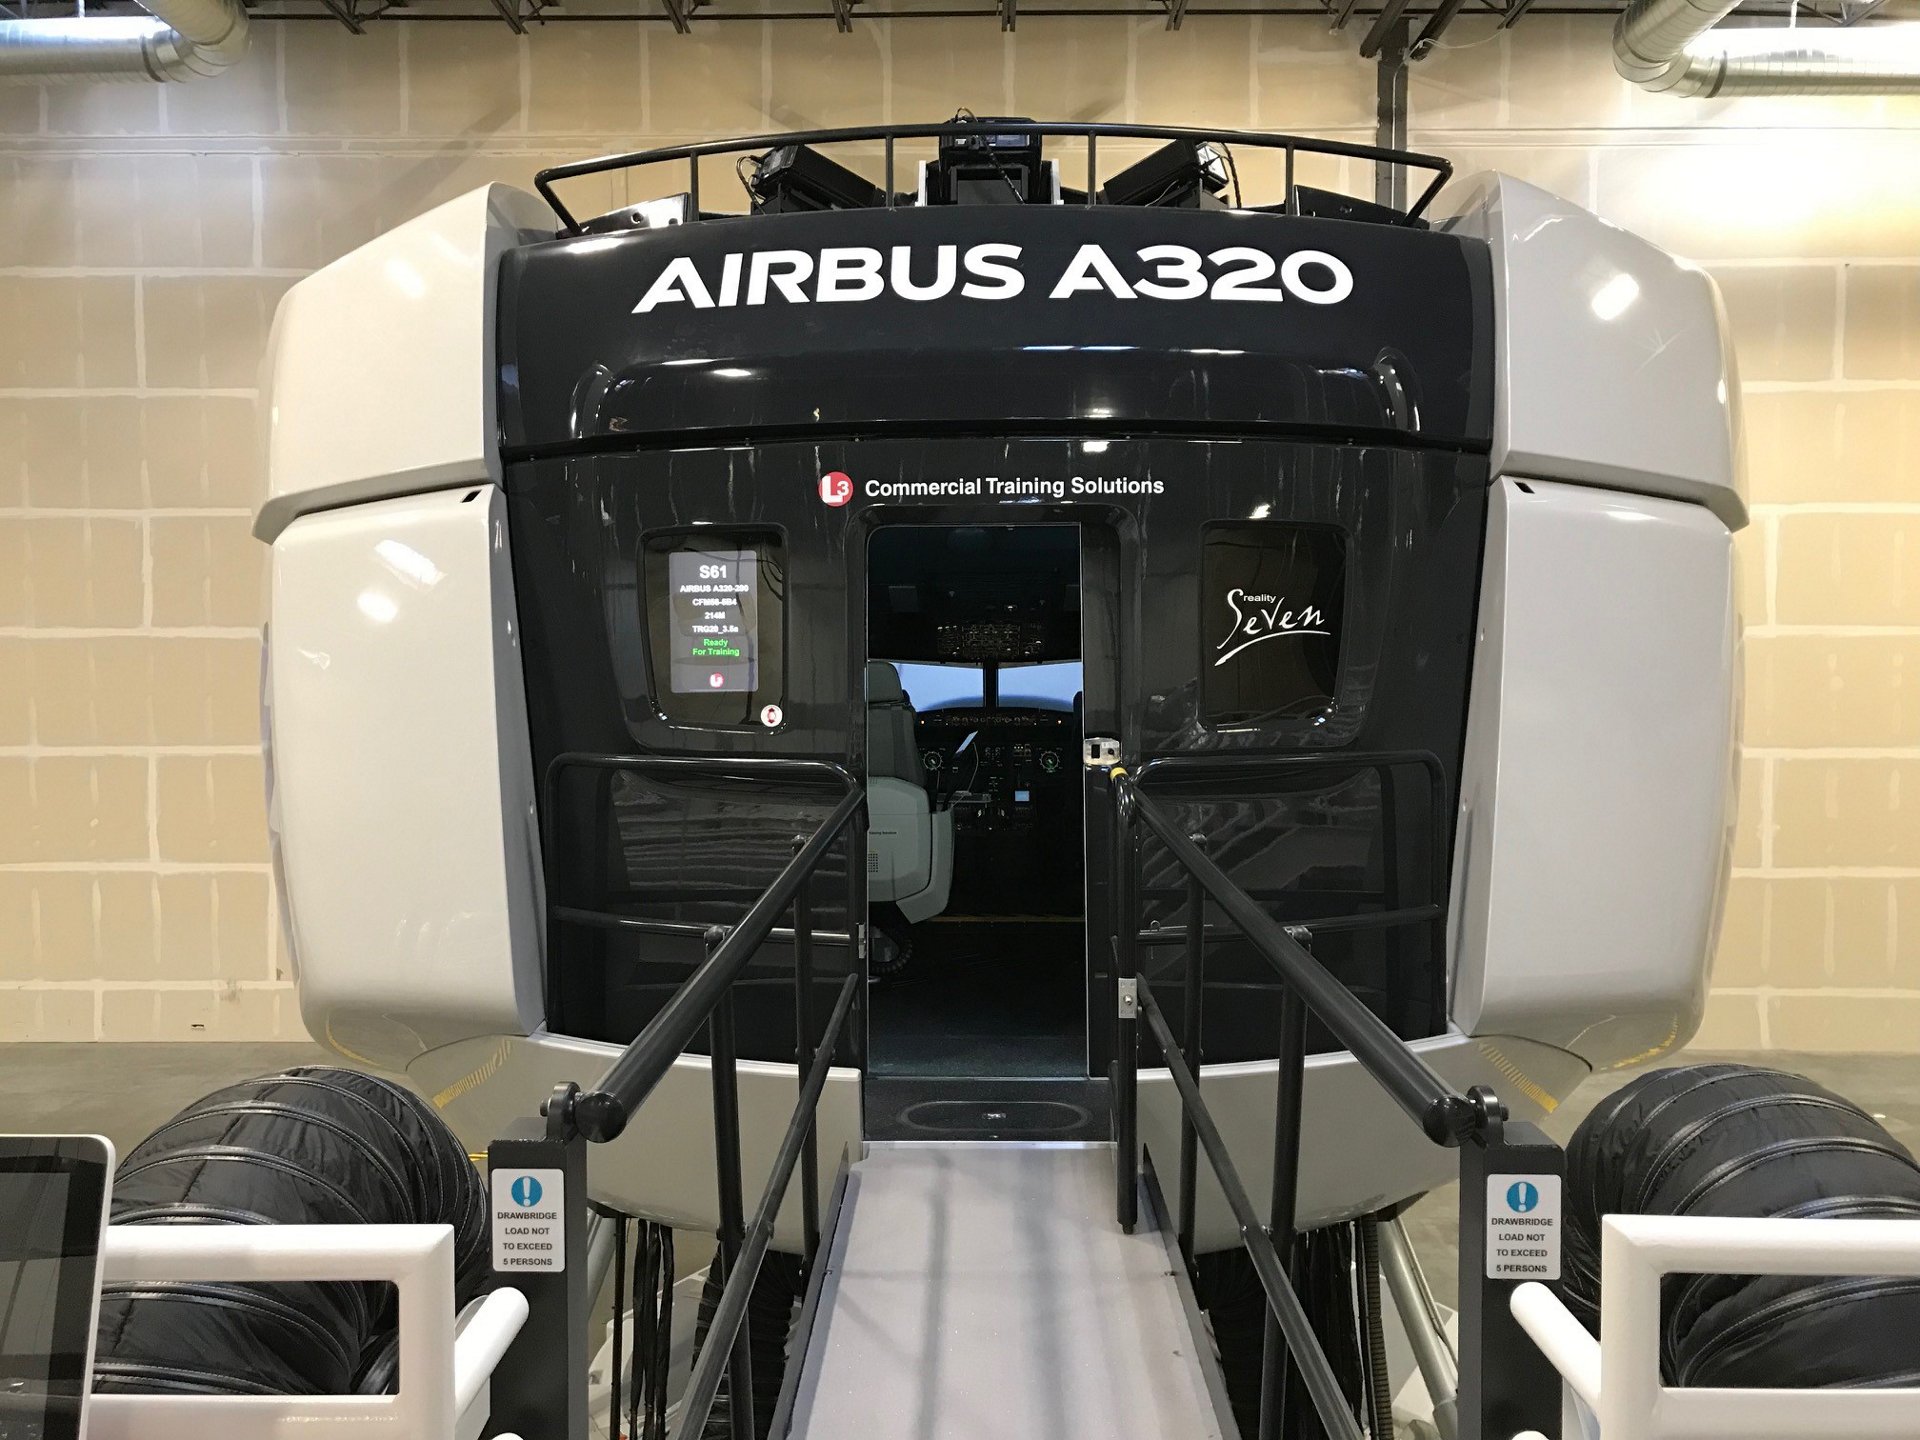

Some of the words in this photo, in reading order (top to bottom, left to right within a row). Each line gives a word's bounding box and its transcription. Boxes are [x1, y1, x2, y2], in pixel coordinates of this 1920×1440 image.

[631, 244, 1026, 313] AIRBUS
[1048, 244, 1354, 305] A320
[865, 477, 981, 497] Commercial
[986, 477, 1065, 497] Training
[1071, 476, 1164, 494] Solutions
[699, 564, 727, 579] S61
[679, 584, 711, 593] AIRBUS
[1243, 593, 1277, 604] reality
[703, 638, 729, 648] Ready
[692, 648, 707, 656] For
[708, 648, 740, 657] Training
[497, 1211, 558, 1220] DRAWBRIDGE
[1491, 1217, 1554, 1226] DRAWBRIDGE
[504, 1227, 530, 1235] LOAD
[531, 1227, 550, 1235] NOT
[1498, 1233, 1524, 1241] LOAD
[1526, 1233, 1546, 1241] NOT
[502, 1242, 515, 1251] TO
[516, 1242, 553, 1251] EXCEED
[1496, 1248, 1509, 1257] TO
[1510, 1248, 1548, 1257] EXCEED
[503, 1257, 509, 1266] 5
[510, 1257, 553, 1266] PERSONS
[1496, 1264, 1502, 1272] 5
[1503, 1264, 1548, 1273] PERSONS
